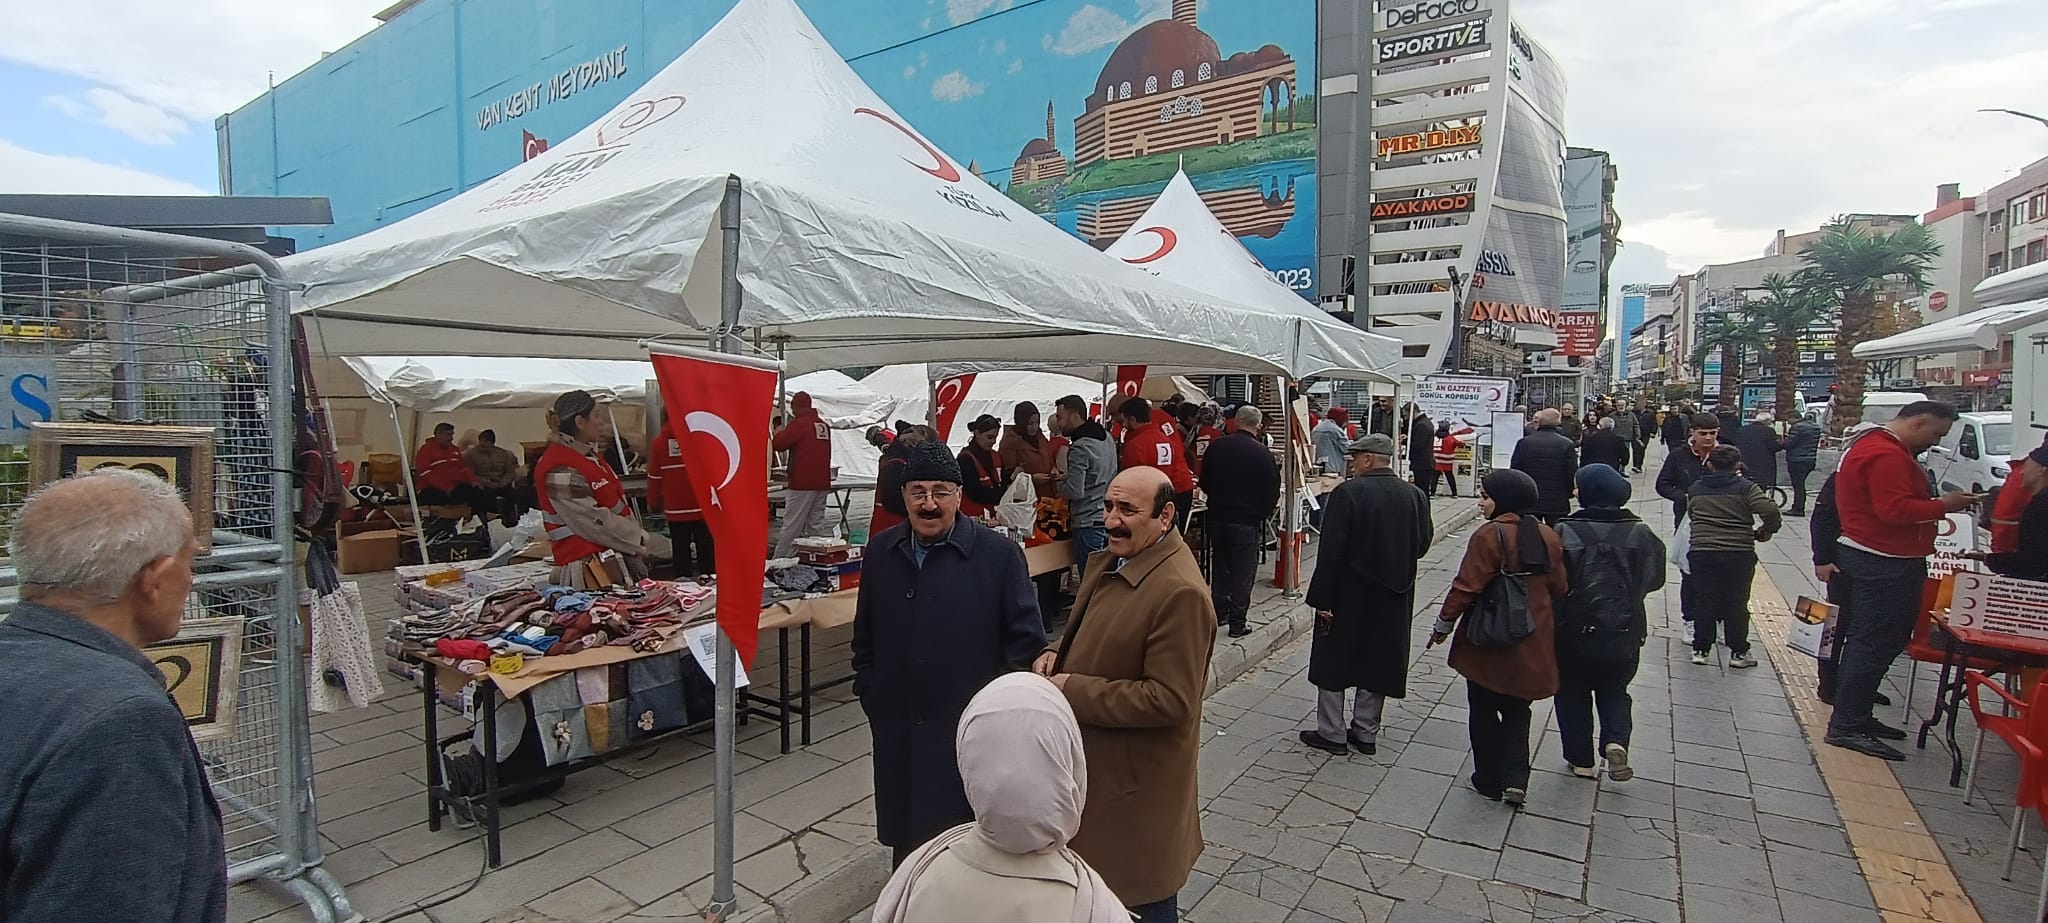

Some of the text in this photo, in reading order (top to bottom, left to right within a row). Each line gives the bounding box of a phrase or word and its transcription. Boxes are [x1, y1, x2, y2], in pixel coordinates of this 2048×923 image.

[1387, 0, 1478, 28] DeFacto
[1381, 24, 1484, 59] SPORTIVE
[477, 44, 629, 132] VAN KENT MEYDANI
[1378, 125, 1482, 155] MR D.I.Y.
[531, 152, 623, 181] KAN
[1372, 195, 1470, 218] AYAKMOD
[1272, 268, 1312, 290] 023
[1470, 301, 1559, 328] AYAKMOD
[1419, 391, 1480, 401] GÖNÜL KÖPRÜSÜ
[1447, 385, 1482, 393] GAZZE'YE
[1934, 551, 1960, 560] KAN
